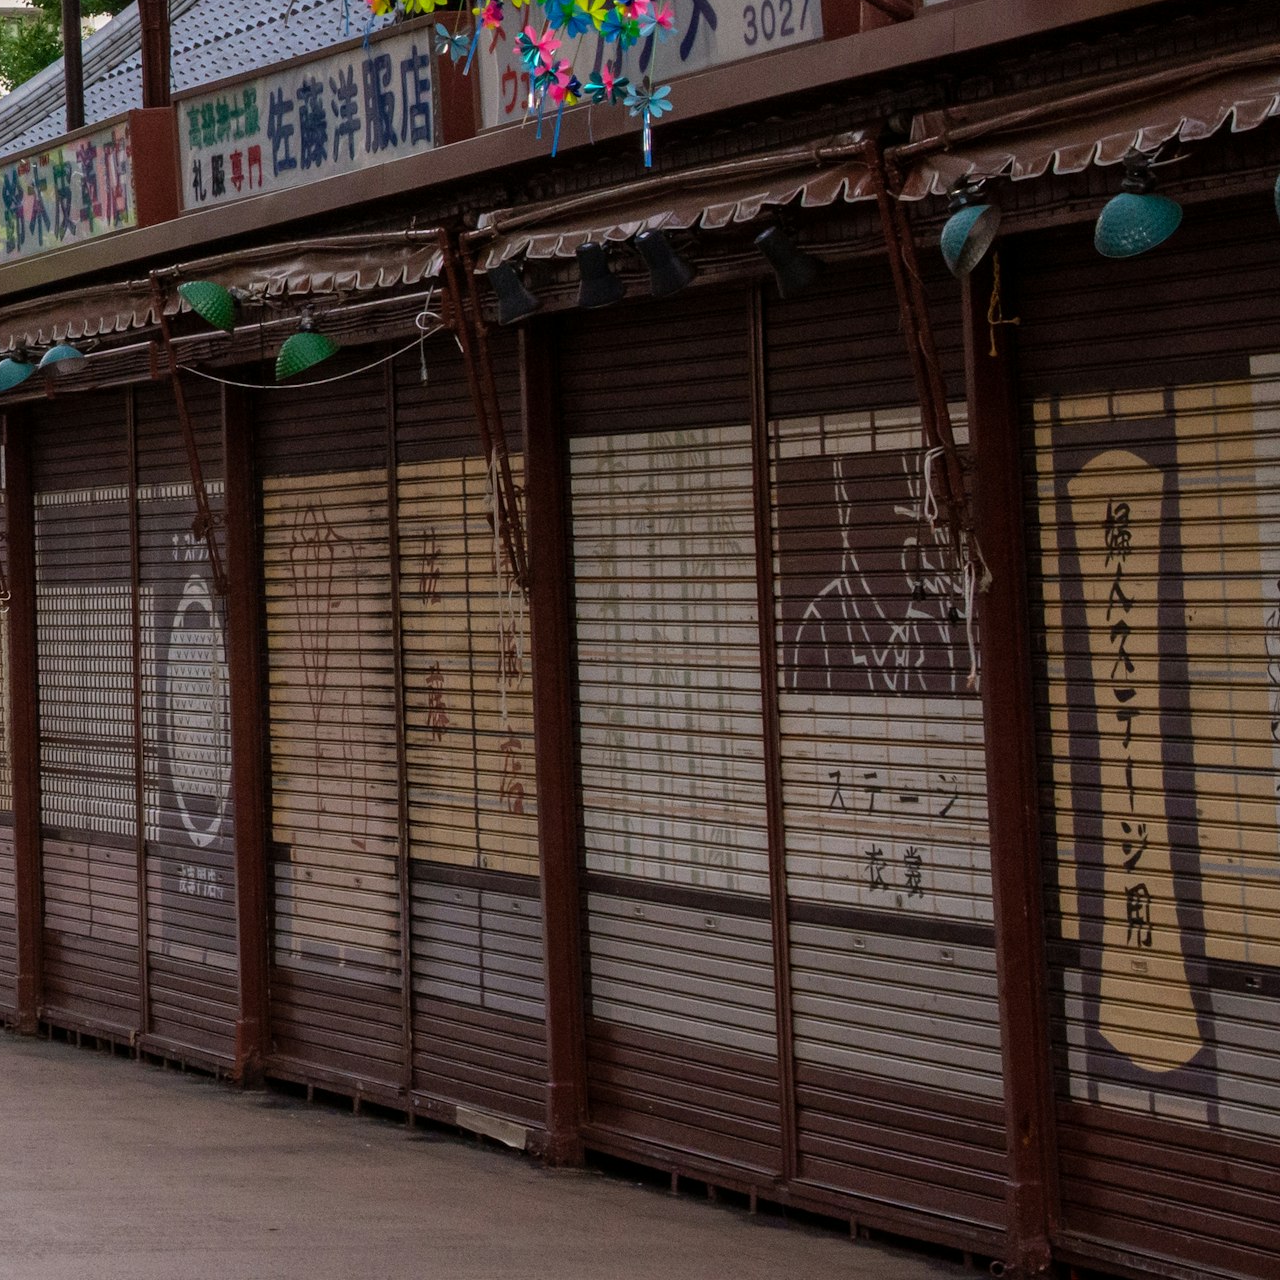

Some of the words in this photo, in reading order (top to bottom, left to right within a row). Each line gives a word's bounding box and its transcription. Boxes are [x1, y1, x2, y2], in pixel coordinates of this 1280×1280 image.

[266, 44, 432, 178] 佐藤洋服店
[192, 144, 264, 202] 礼服専門
[1104, 497, 1154, 951] 婦人ステージ用
[828, 770, 958, 817] ステージ
